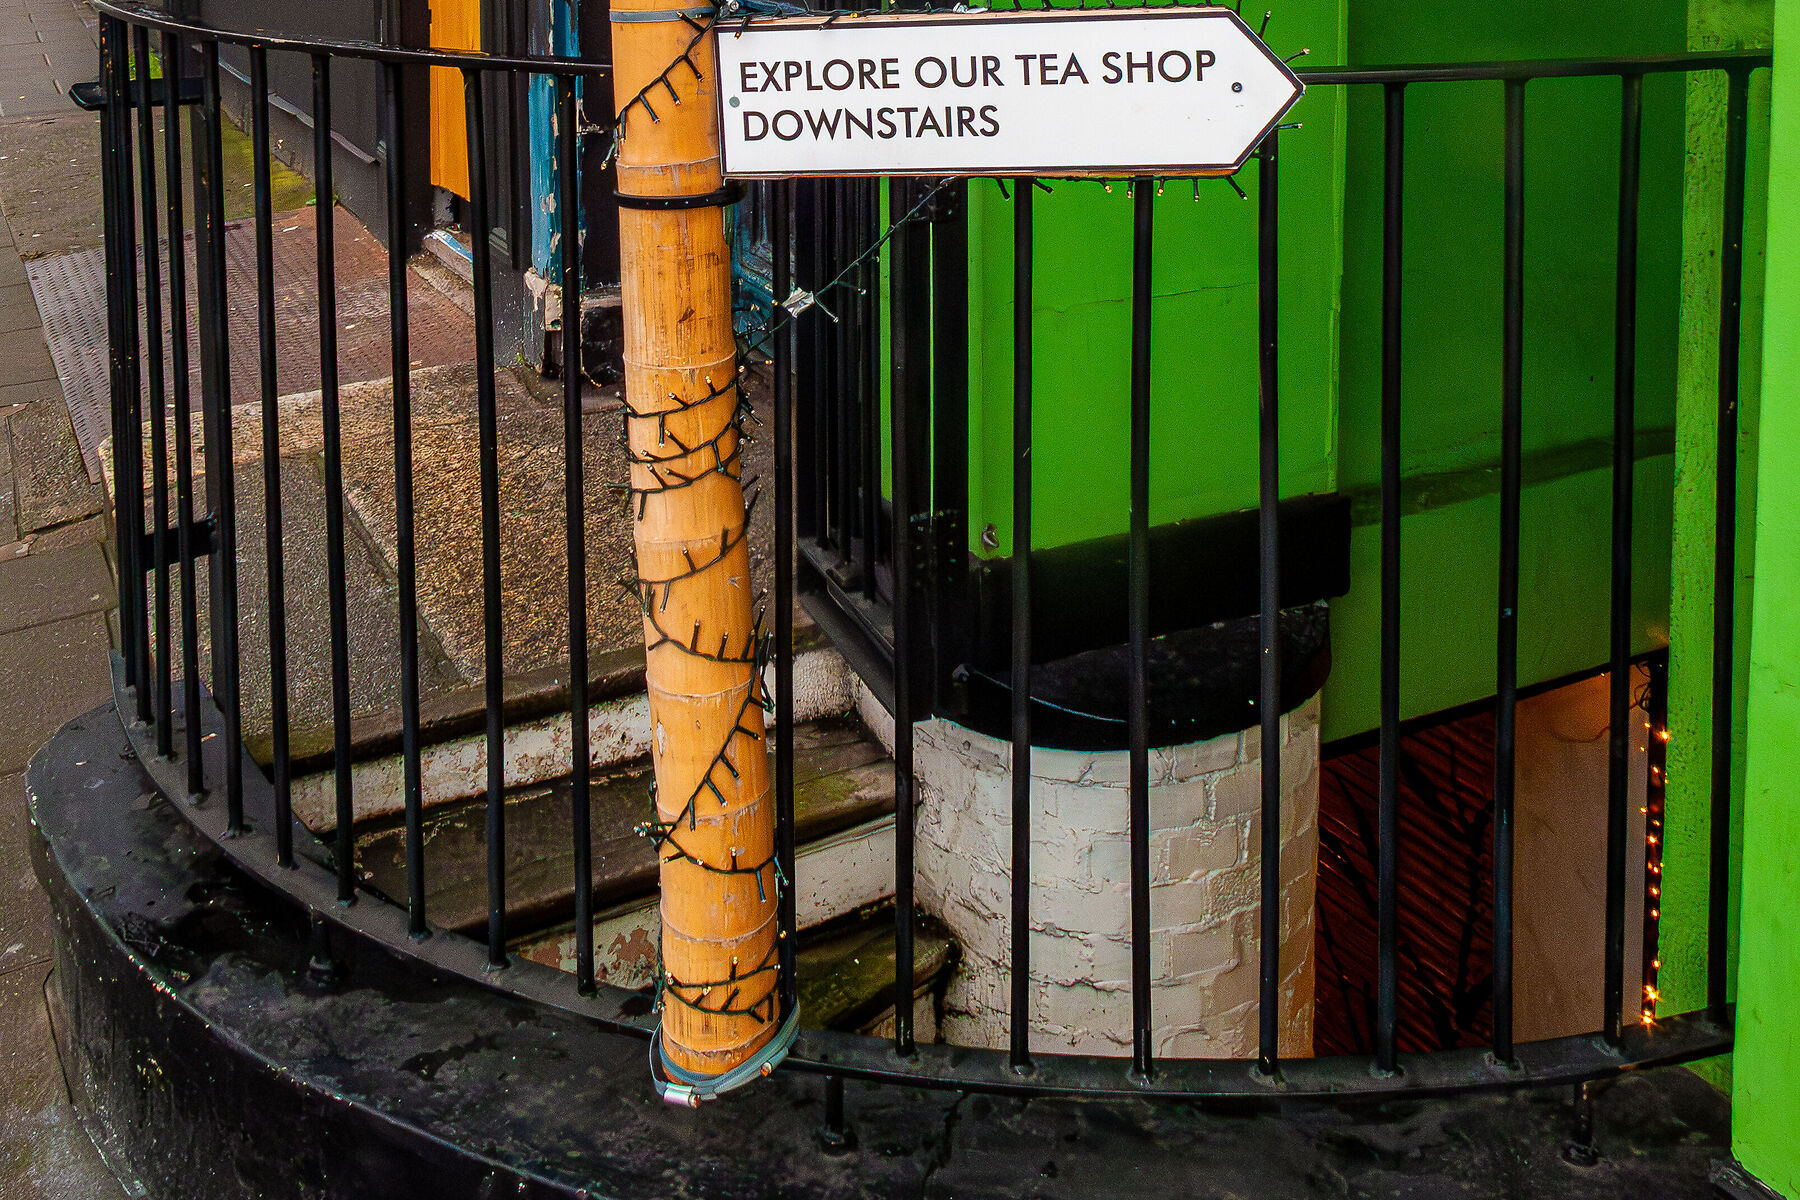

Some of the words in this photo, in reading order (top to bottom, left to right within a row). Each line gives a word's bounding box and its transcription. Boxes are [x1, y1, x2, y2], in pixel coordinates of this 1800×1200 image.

[739, 57, 900, 93] EXPLORE
[914, 55, 1005, 89] OUR
[1014, 52, 1090, 86] TEA
[1102, 49, 1216, 85] SHOP
[742, 104, 1000, 142] DOWNSTAIRS
